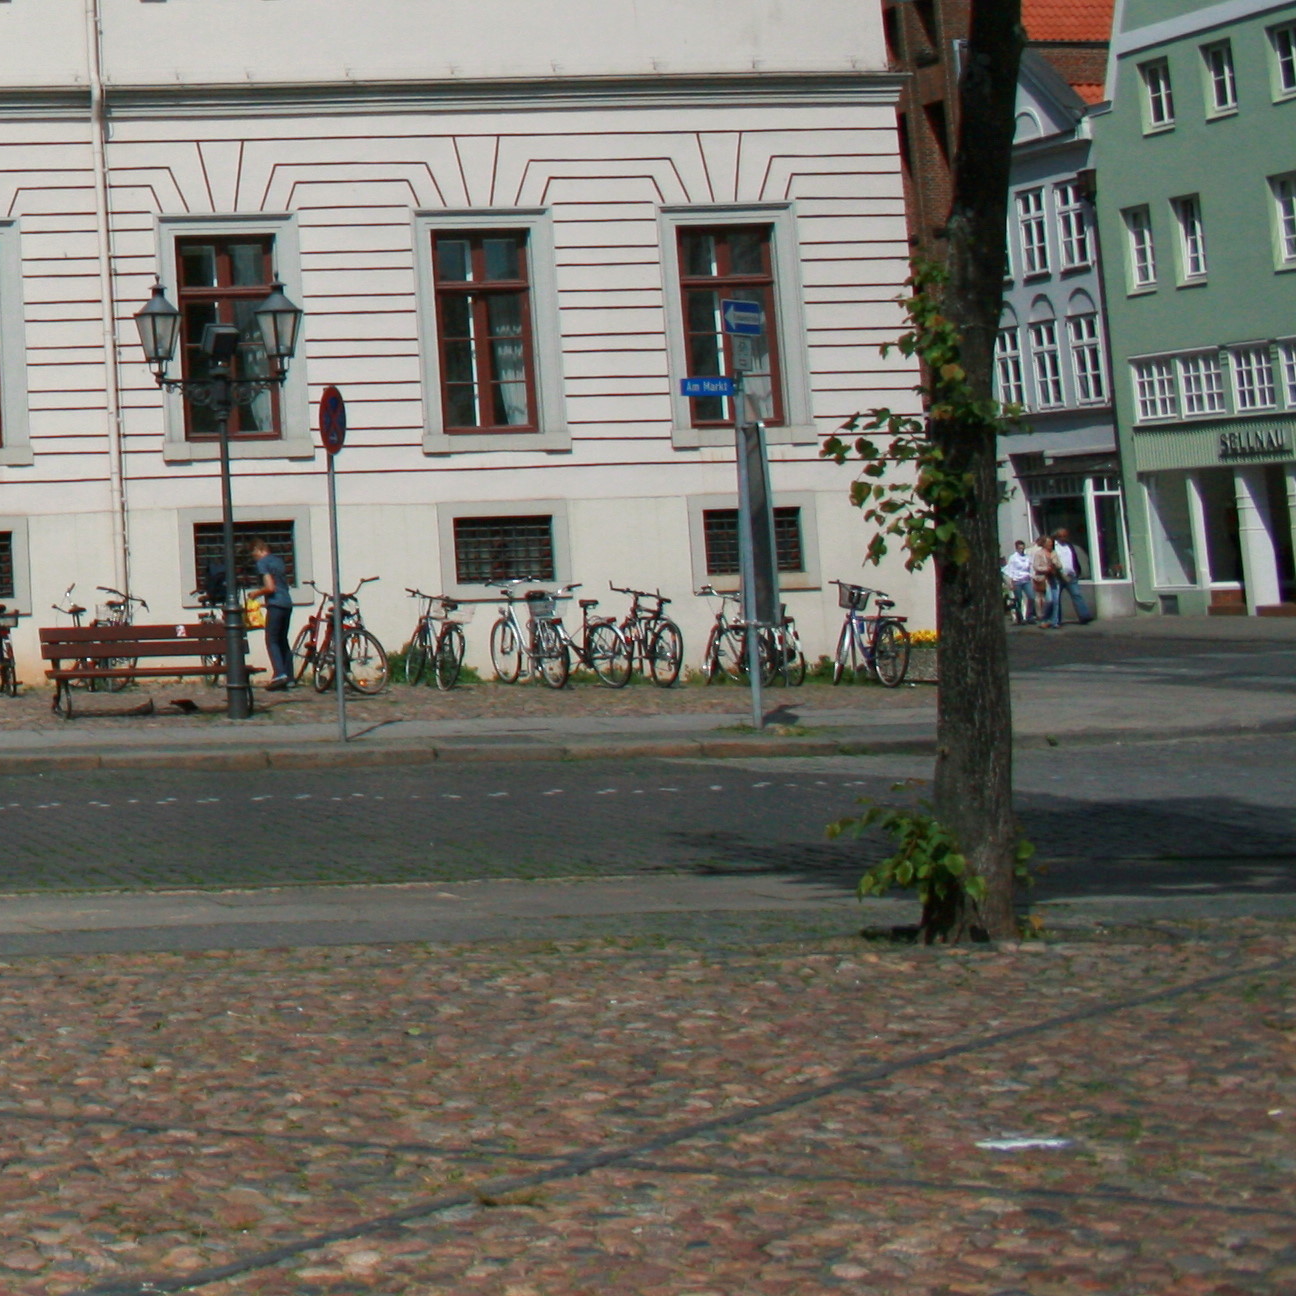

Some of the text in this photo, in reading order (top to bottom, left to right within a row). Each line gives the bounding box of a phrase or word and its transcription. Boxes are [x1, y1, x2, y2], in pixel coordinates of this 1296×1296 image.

[686, 381, 728, 392] Am Markt
[1219, 429, 1285, 453] SELLNAU
